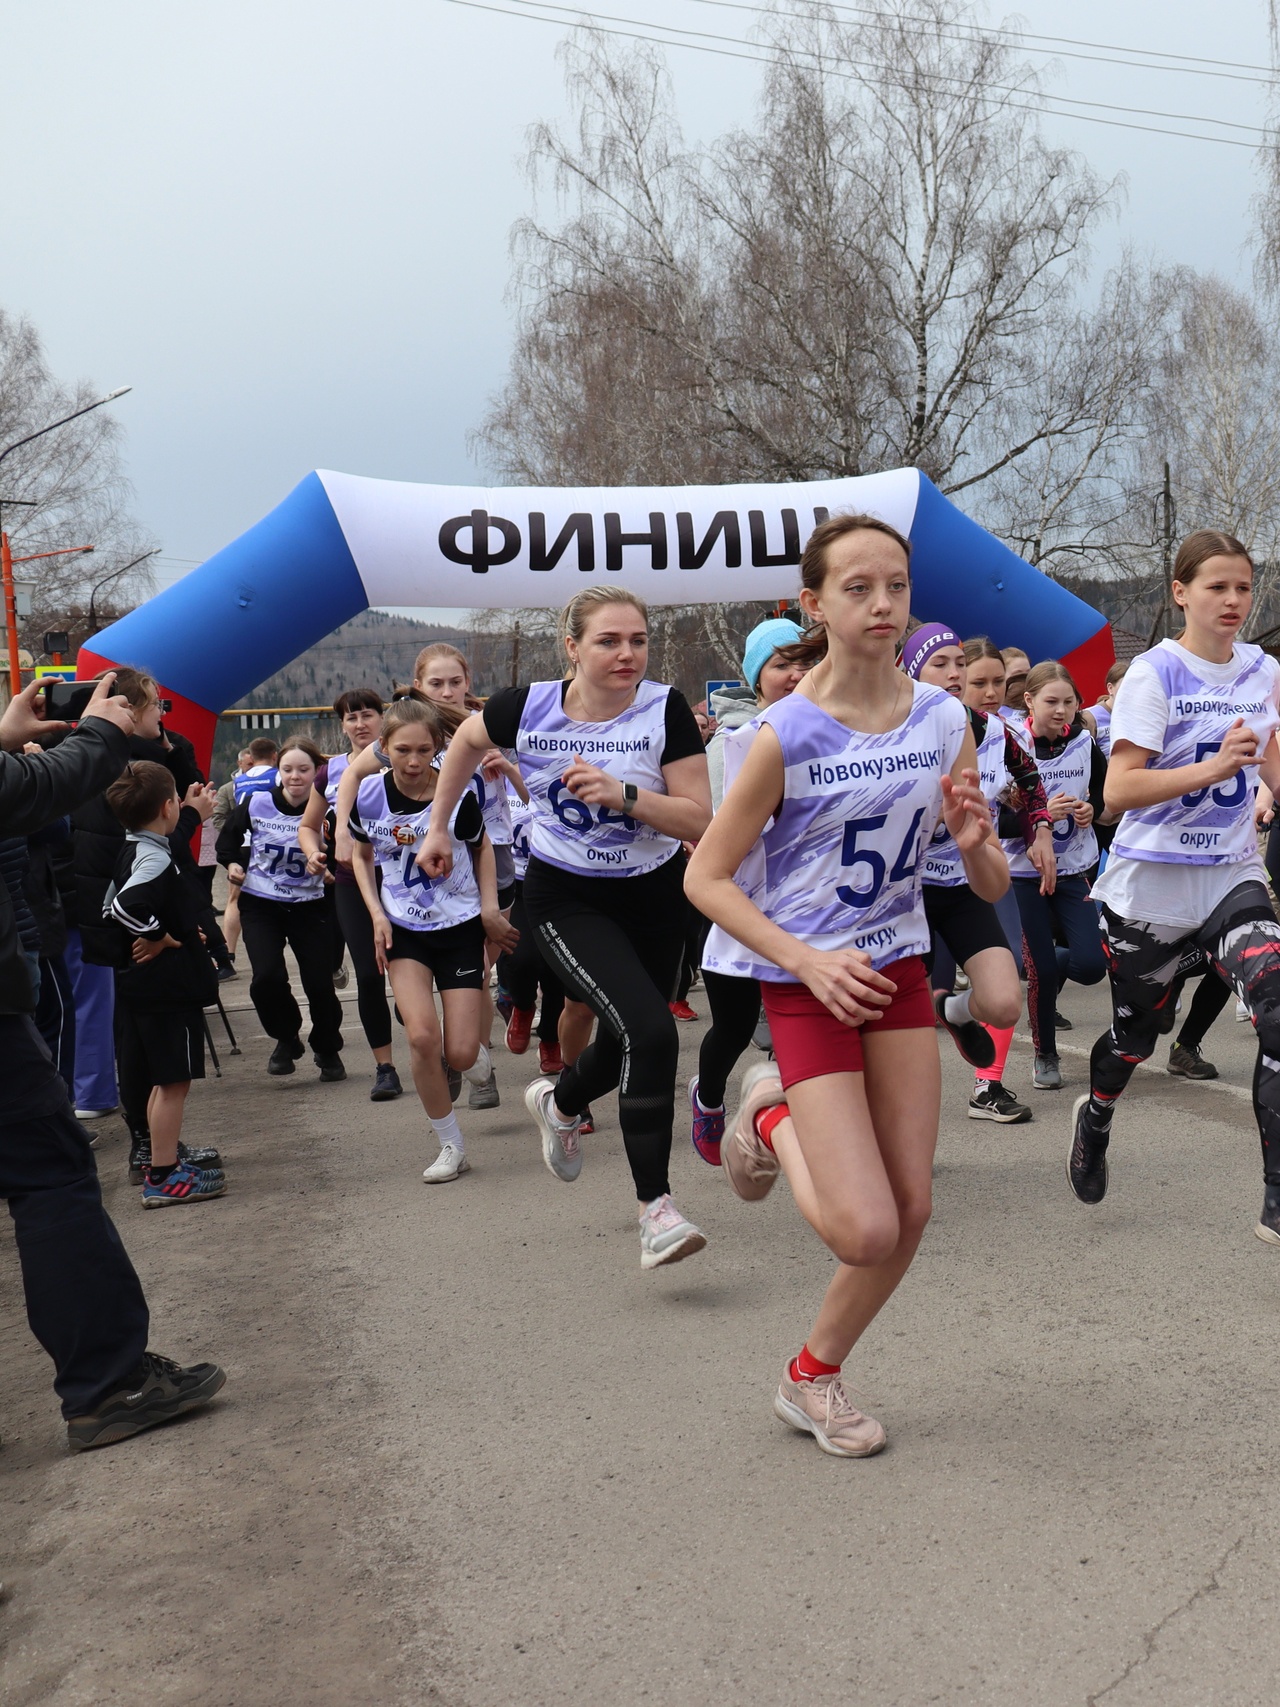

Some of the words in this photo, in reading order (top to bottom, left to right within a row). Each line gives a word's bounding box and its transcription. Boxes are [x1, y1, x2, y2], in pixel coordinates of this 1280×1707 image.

[528, 735, 650, 755] Новокузнецкий
[1040, 767, 1084, 780] кузнецкий
[1180, 832, 1221, 849] округ
[265, 843, 305, 878] 75
[587, 848, 629, 864] округ
[836, 807, 927, 909] 54
